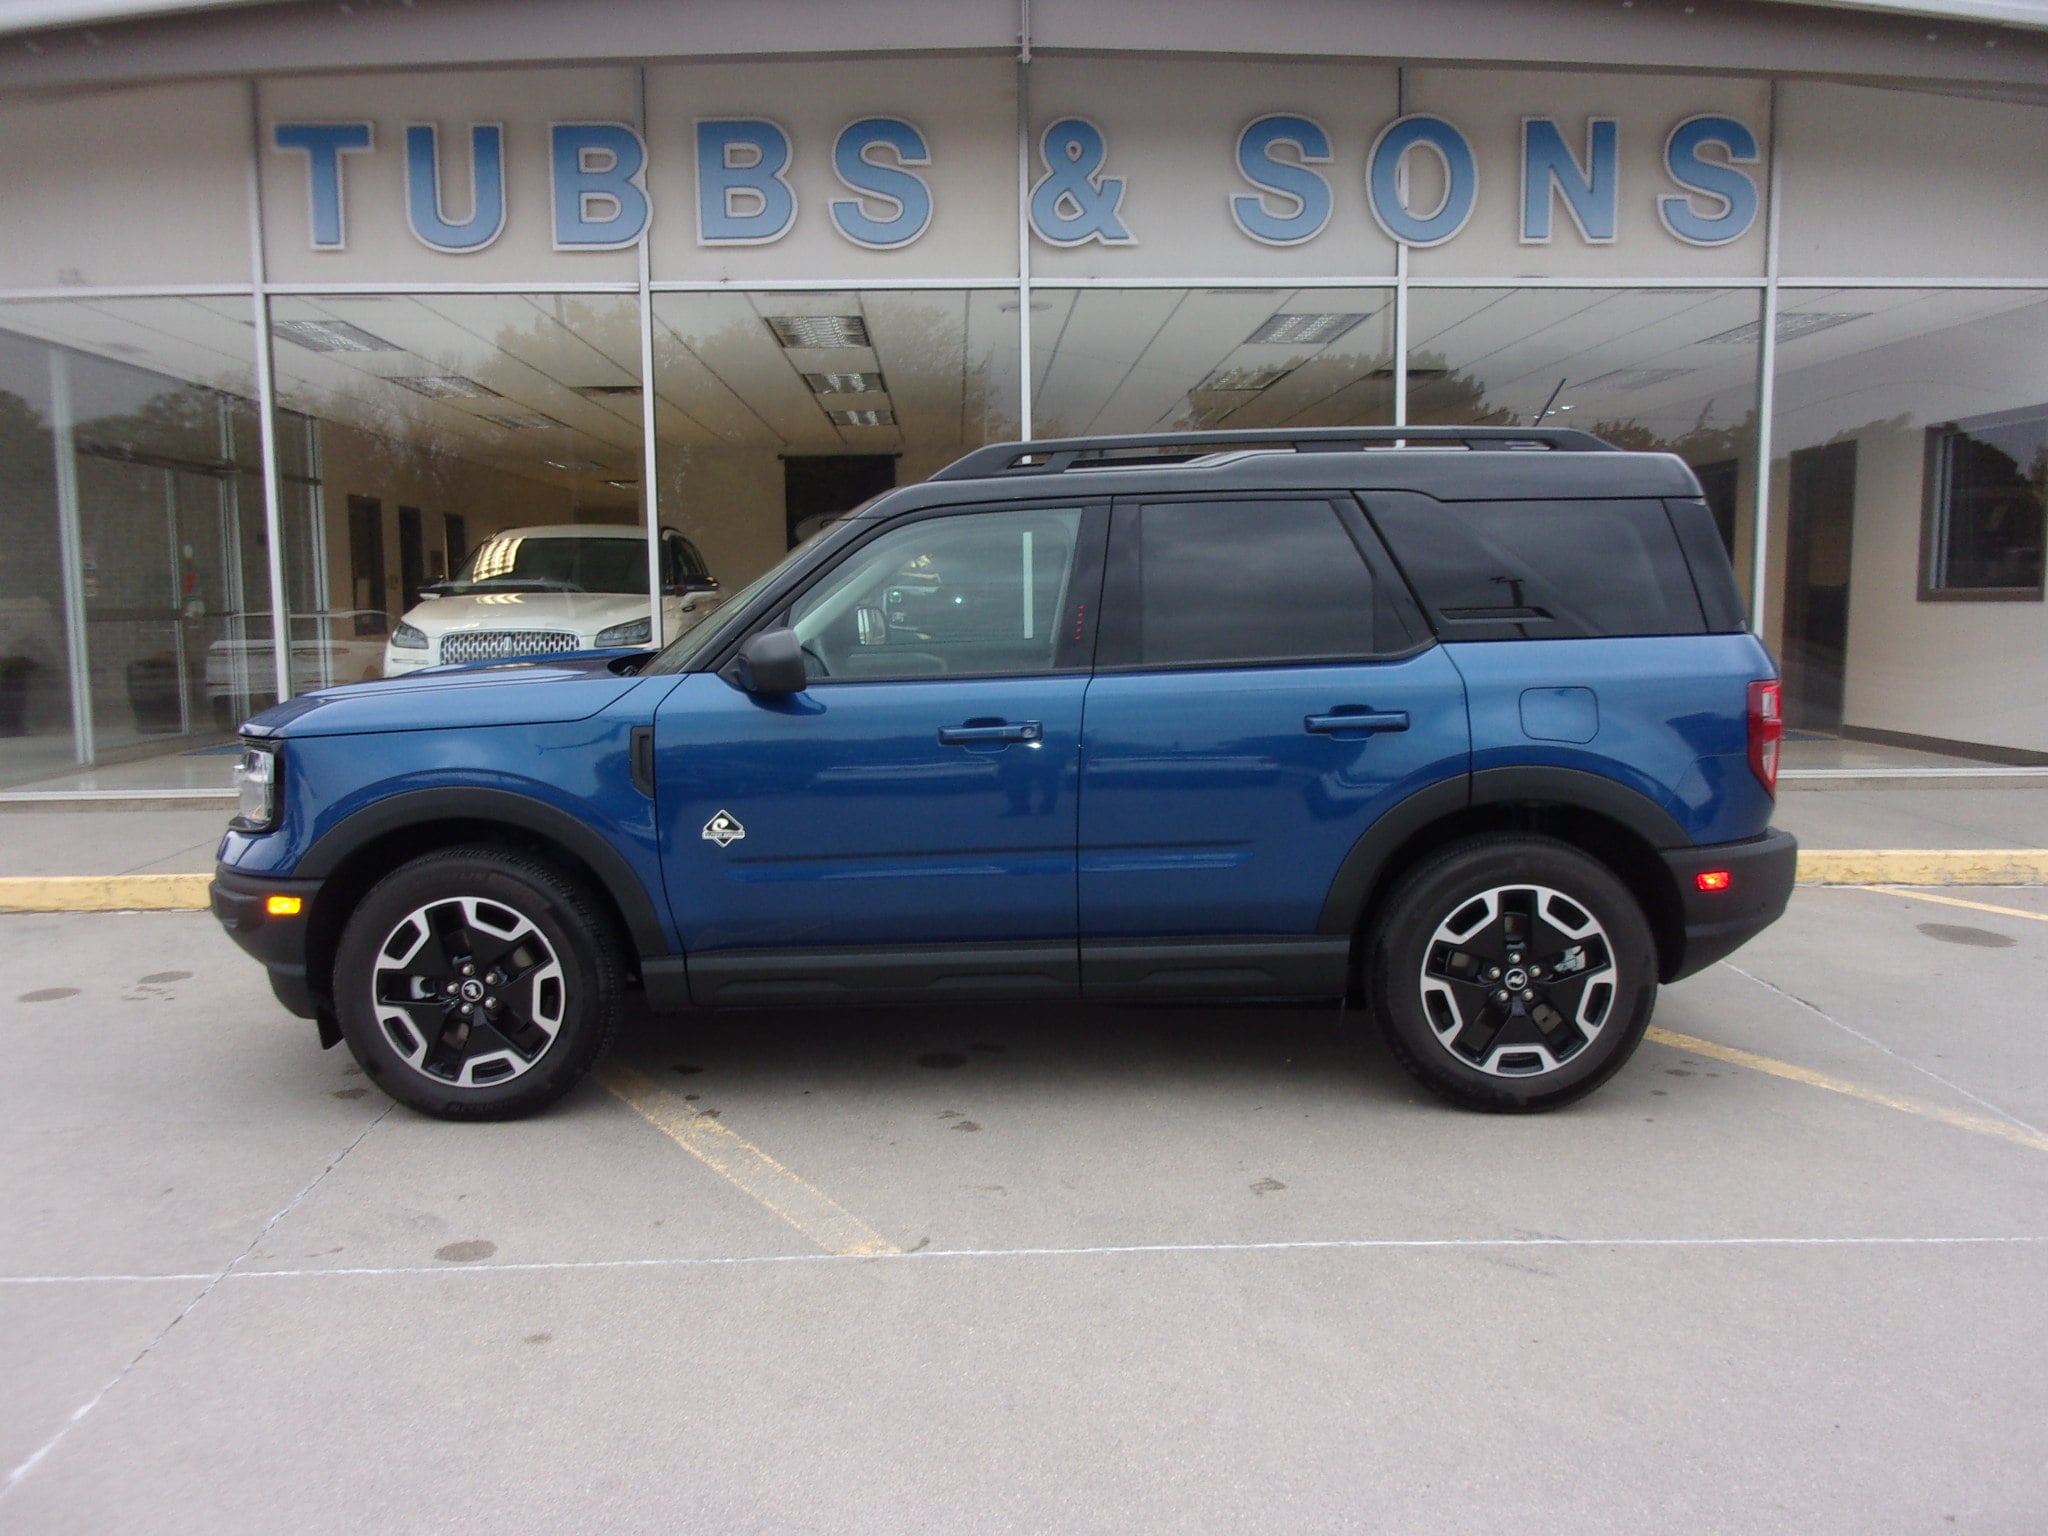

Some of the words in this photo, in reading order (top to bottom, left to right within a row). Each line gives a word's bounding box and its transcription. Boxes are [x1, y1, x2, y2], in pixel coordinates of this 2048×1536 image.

[274, 116, 936, 254] TUBBS
[1028, 115, 1139, 248] &
[1228, 111, 1762, 249] SONS
